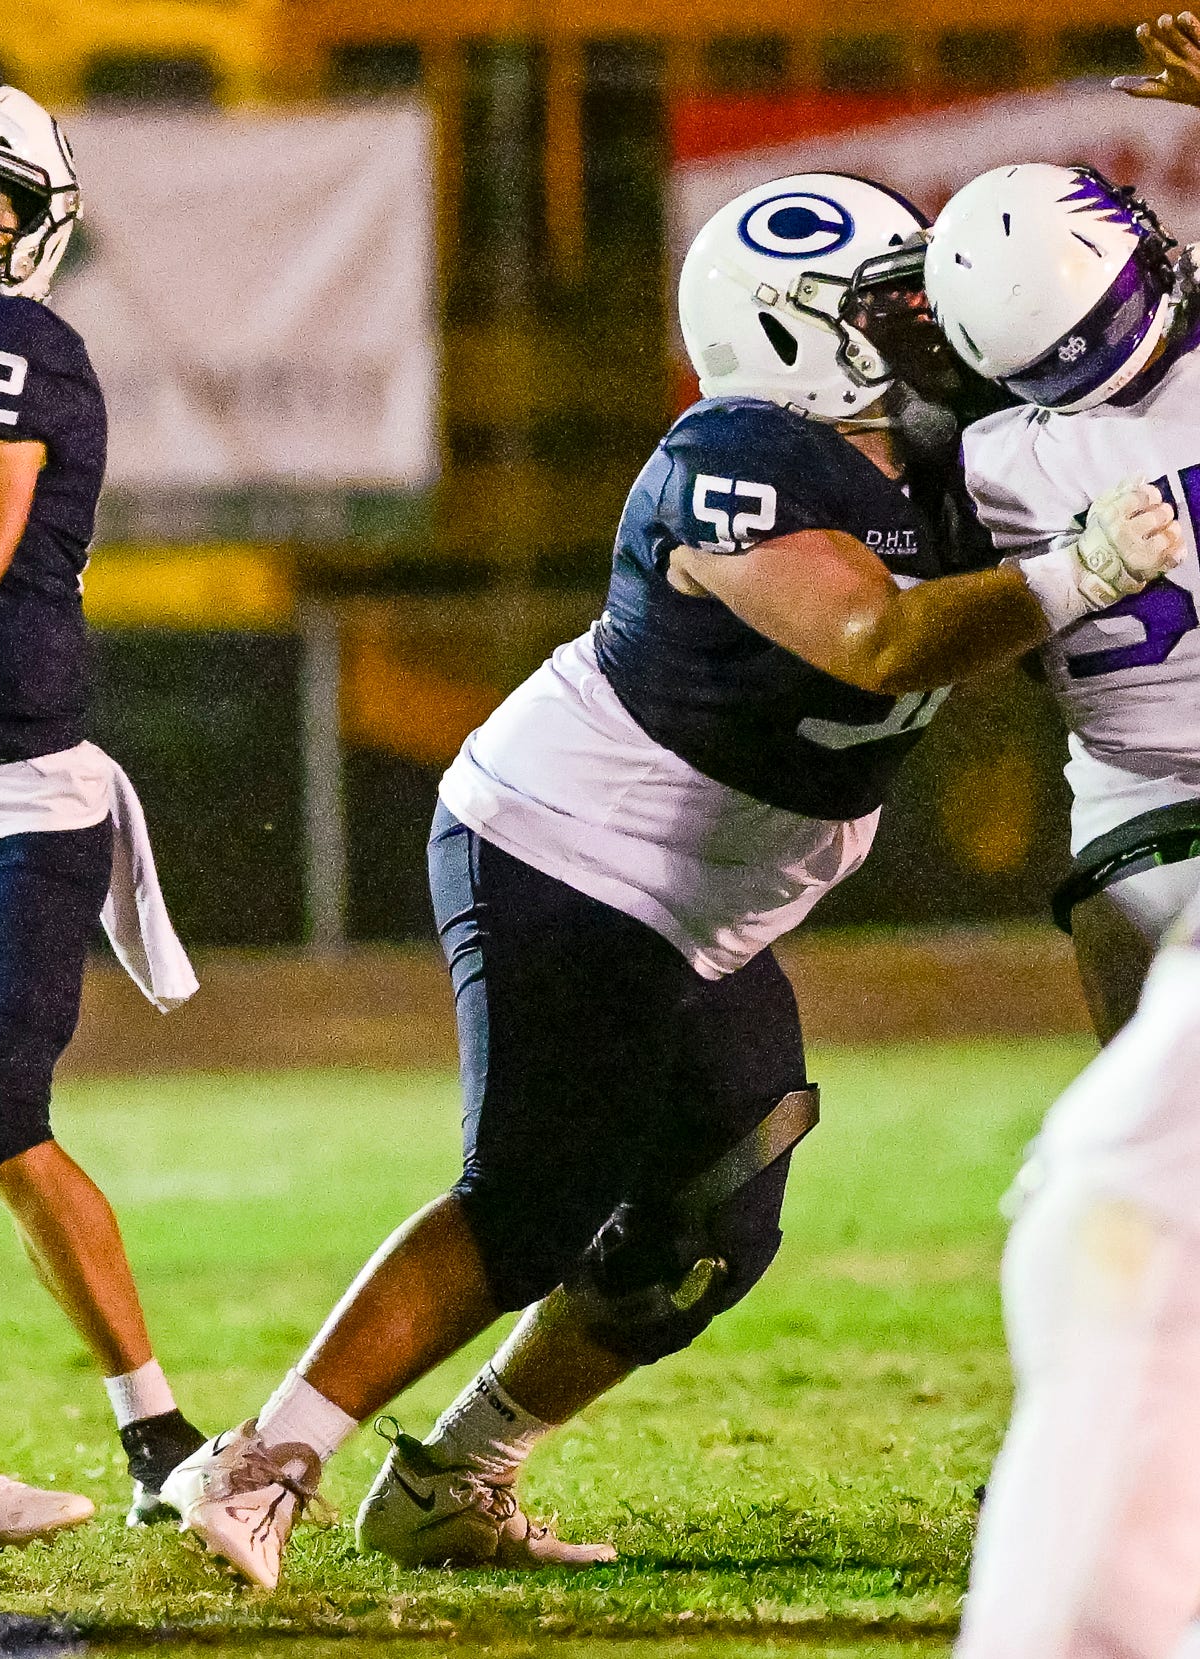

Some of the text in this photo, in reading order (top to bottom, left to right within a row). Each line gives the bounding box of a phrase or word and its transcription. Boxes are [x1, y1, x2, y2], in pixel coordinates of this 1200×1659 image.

[737, 192, 855, 260] C
[692, 473, 777, 554] 52
[866, 529, 917, 548] D.H.T.
